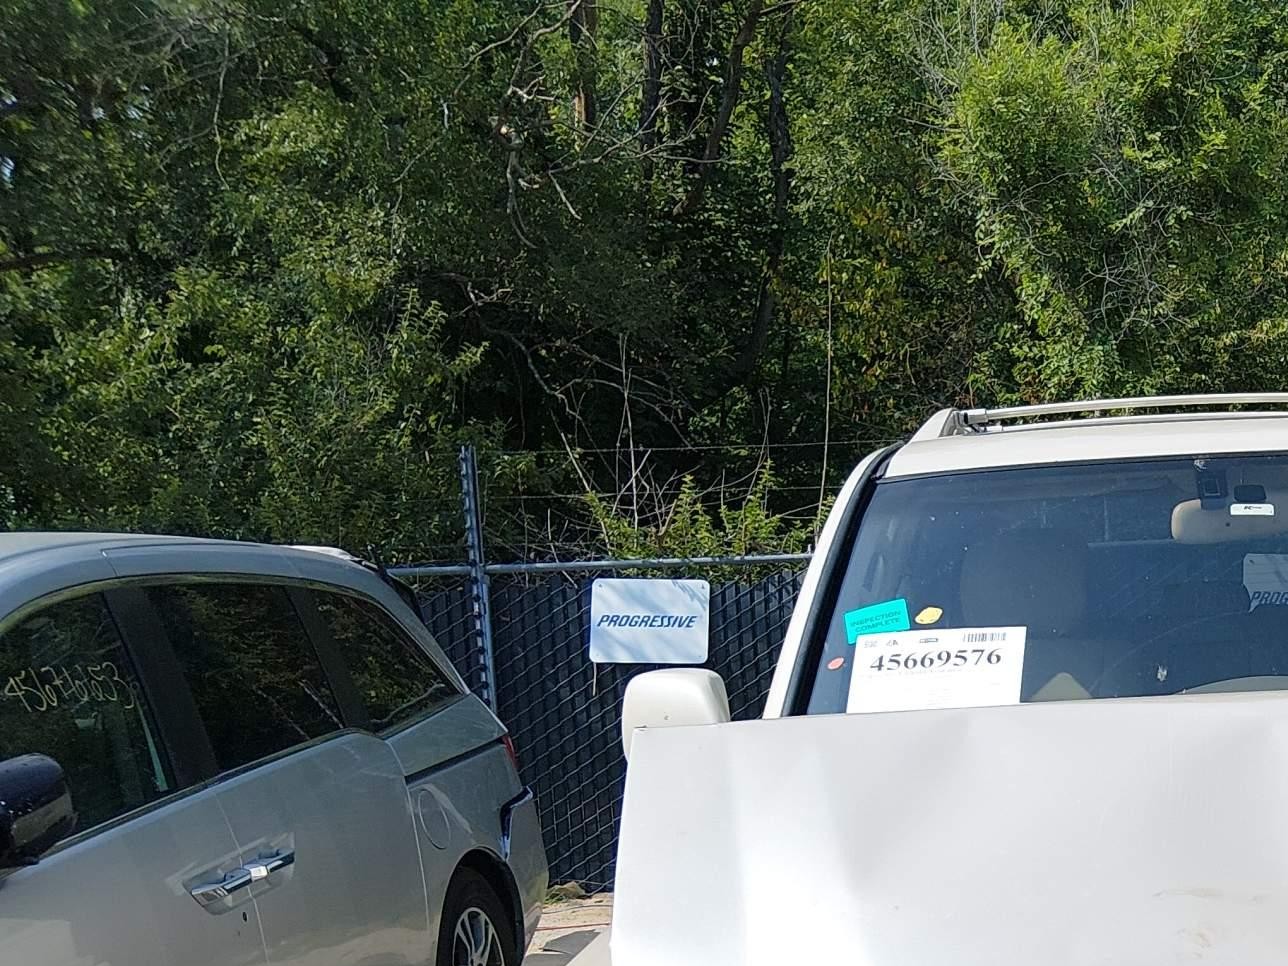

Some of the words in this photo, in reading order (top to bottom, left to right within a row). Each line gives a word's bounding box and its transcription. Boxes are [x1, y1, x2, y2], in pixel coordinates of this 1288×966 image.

[597, 614, 698, 628] PROGRESSIVE
[849, 610, 901, 627] INSPECTION
[855, 617, 900, 633] COMPLETE
[870, 648, 1002, 671] 45669576
